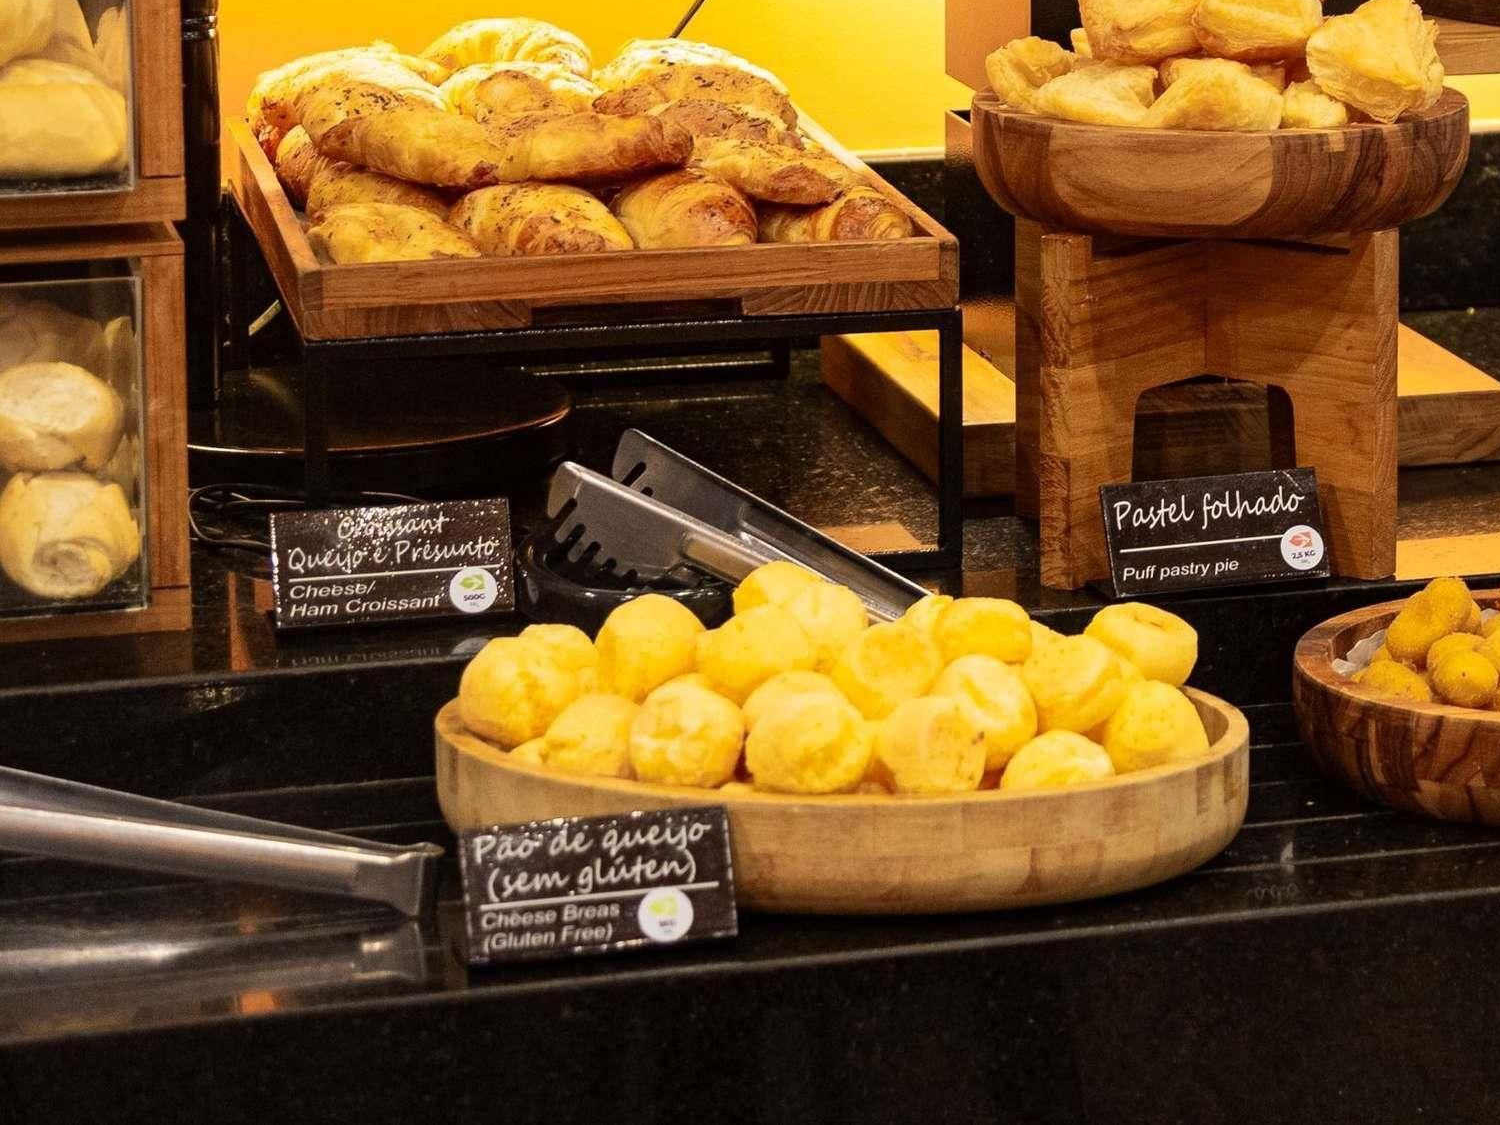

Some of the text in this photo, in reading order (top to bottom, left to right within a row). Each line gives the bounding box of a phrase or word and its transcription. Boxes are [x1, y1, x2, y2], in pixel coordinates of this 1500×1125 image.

[1113, 485, 1306, 531] Pastel folhado
[288, 535, 496, 574] Queijo e Presunto
[1122, 557, 1240, 582] Puff pastry pie
[288, 580, 377, 600] Cheese/
[290, 595, 442, 619] Ham Croissant
[472, 815, 712, 864] Pão de queijo
[487, 848, 697, 903] (sem glúten)
[481, 908, 558, 930] Cheese
[482, 922, 614, 955] (Gluten Free)
